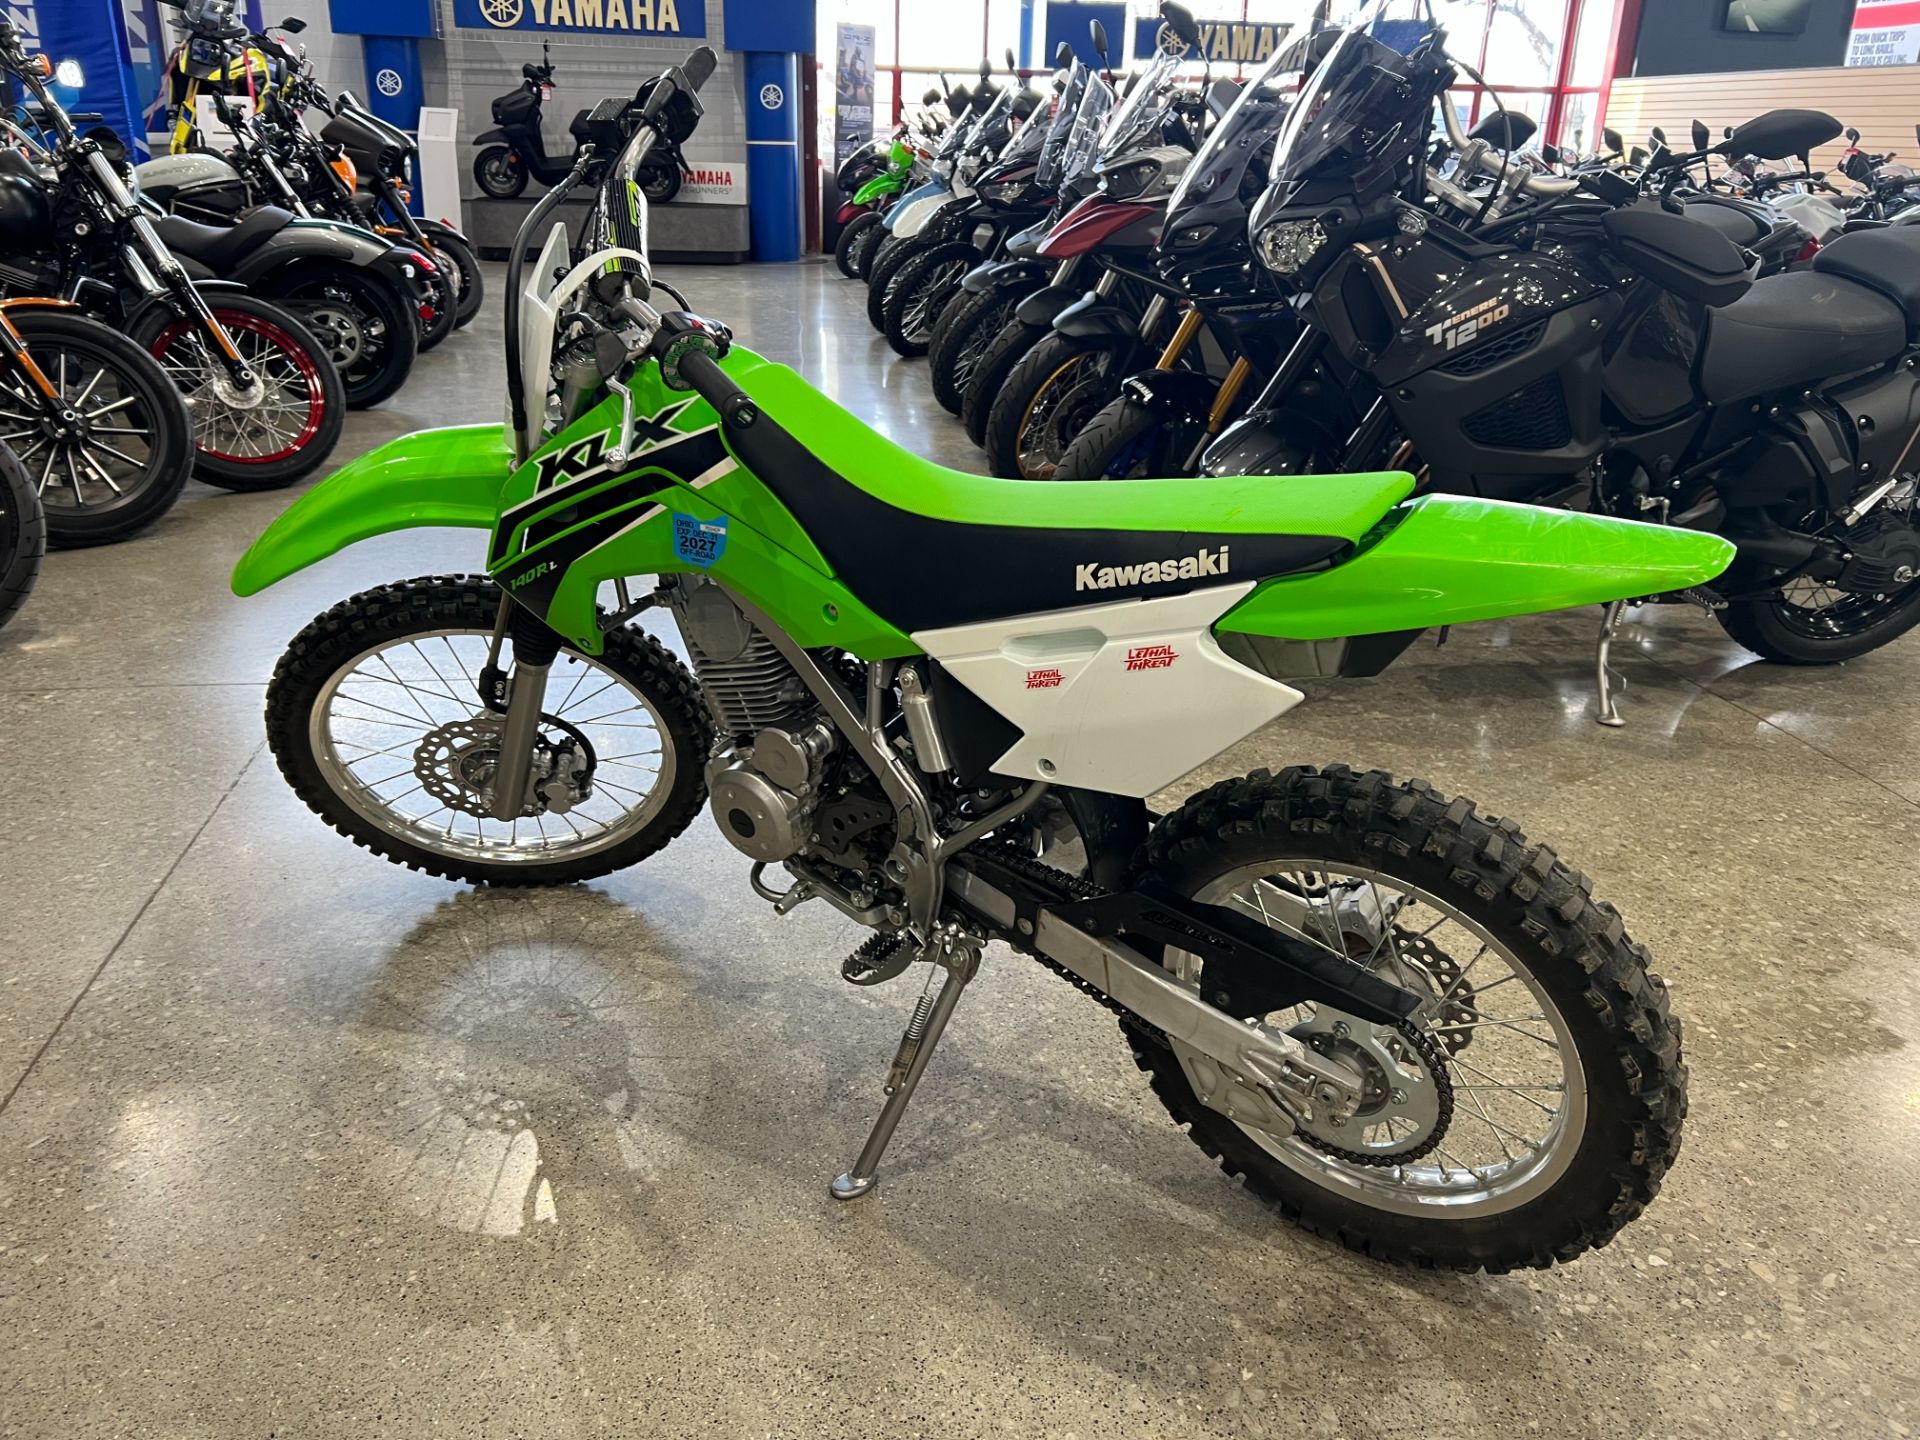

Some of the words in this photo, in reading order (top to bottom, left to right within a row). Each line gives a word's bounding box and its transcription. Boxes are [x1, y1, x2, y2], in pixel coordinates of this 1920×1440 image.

[530, 0, 680, 32] YAMAHA
[1854, 34, 1870, 44] FROM
[1871, 32, 1888, 44] QUICK
[1889, 30, 1906, 42] TRIPS
[1852, 46, 1860, 55] TO
[1860, 45, 1875, 55] LONG
[1861, 56, 1876, 65] ROAD
[681, 170, 732, 185] YAMAHA
[1445, 304, 1509, 351] 1200
[1129, 380, 1154, 401] YAMAHA
[533, 395, 700, 497] KLX
[676, 519, 694, 528] OHIO
[680, 535, 717, 552] 2027
[680, 547, 716, 560] OFF-ROAD
[1075, 545, 1229, 591] Kawasaki
[1128, 645, 1174, 660] LETHAL
[1124, 655, 1179, 671] THREAT
[1027, 669, 1062, 680] LETHAL
[1024, 676, 1066, 689] THREAT
